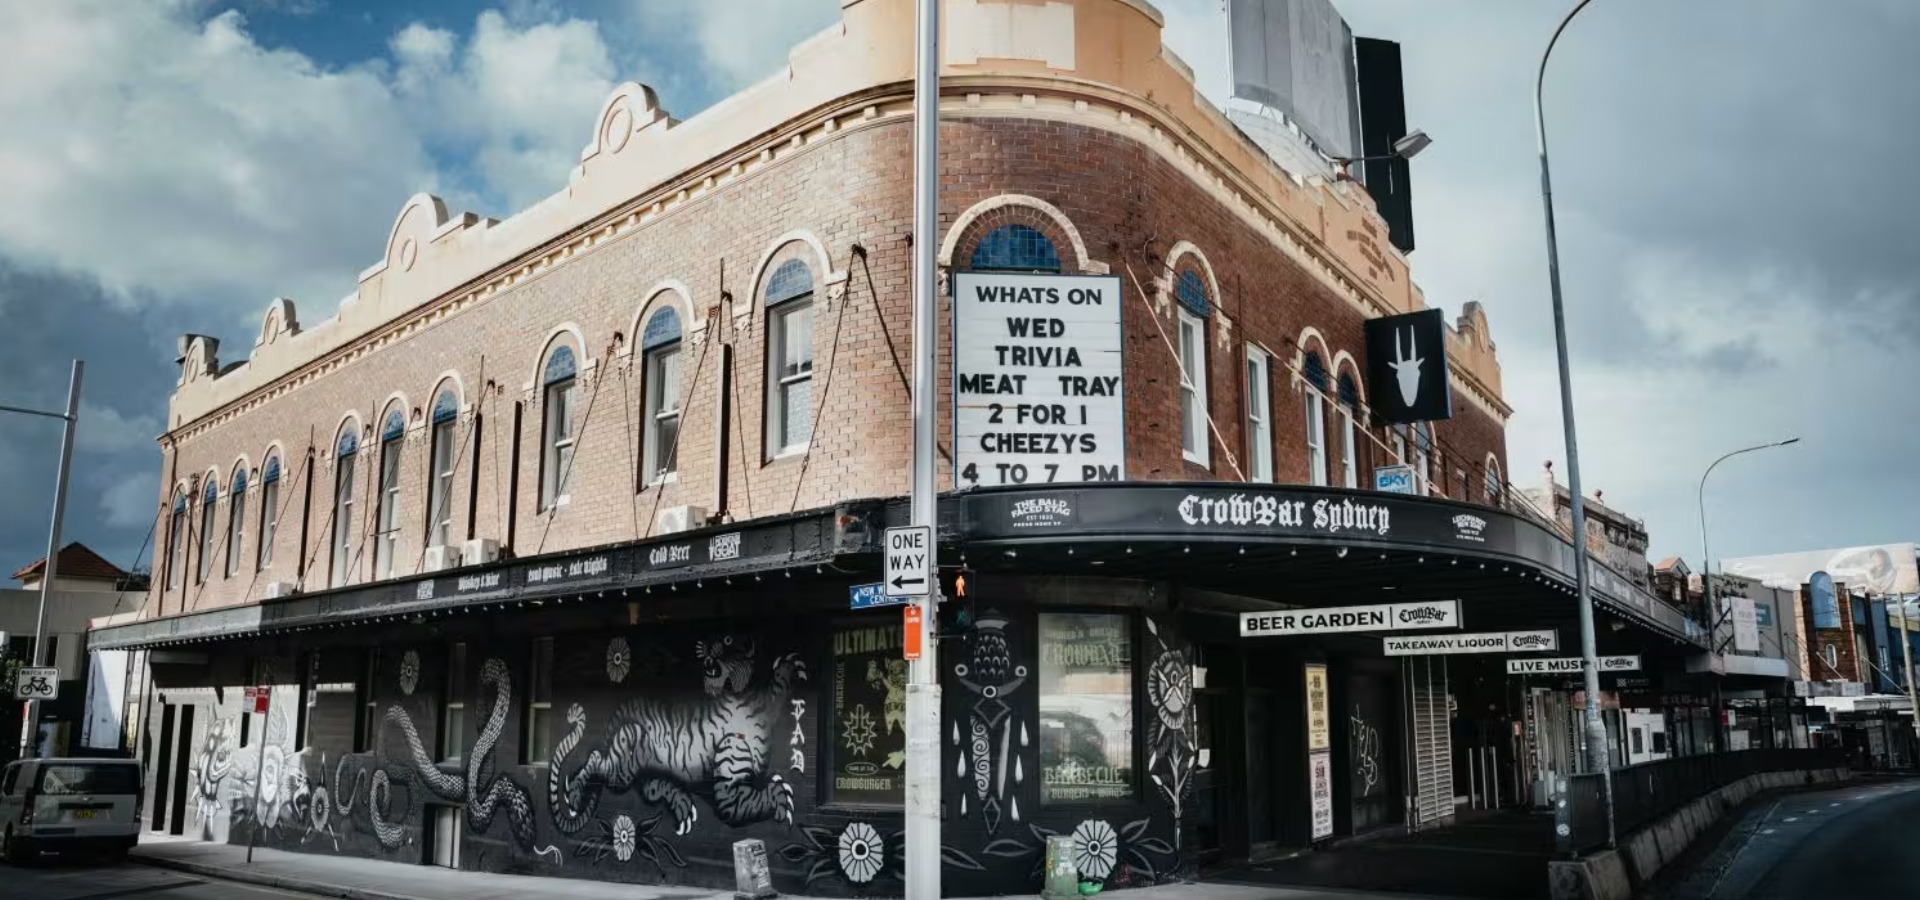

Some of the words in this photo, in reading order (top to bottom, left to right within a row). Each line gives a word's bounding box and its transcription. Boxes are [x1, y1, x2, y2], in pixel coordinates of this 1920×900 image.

[976, 286, 1060, 304] WHATS
[1067, 288, 1102, 305] ON
[1006, 317, 1065, 338] WED
[995, 345, 1082, 367] TRIVIA
[959, 373, 1027, 395] MEAT
[1058, 375, 1120, 397] TRAY
[988, 403, 1003, 424] 2
[1016, 404, 1066, 425] FOR
[980, 432, 1097, 454] CHEEZYS
[962, 462, 979, 483] 4
[996, 463, 1028, 484] TO
[1044, 463, 1060, 483] 7
[1082, 464, 1119, 482] PM
[1011, 505, 1042, 518] FACED
[1044, 504, 1071, 516] STAG
[1014, 499, 1037, 509] THE
[1038, 498, 1067, 508] BALD
[1312, 498, 1391, 535] Sydney
[892, 533, 923, 549] ONE
[714, 543, 741, 559] GOAT
[890, 554, 925, 571] WAY
[860, 586, 875, 597] NSW
[1247, 616, 1296, 631] BEER
[1301, 611, 1384, 628] GARDEN
[1387, 640, 1454, 650] TAKEAWAY
[1457, 638, 1504, 648] LIQUOR
[1512, 661, 1544, 671] LIVE
[1547, 660, 1585, 671] MUSI
[1043, 767, 1124, 784] BARBECUE
